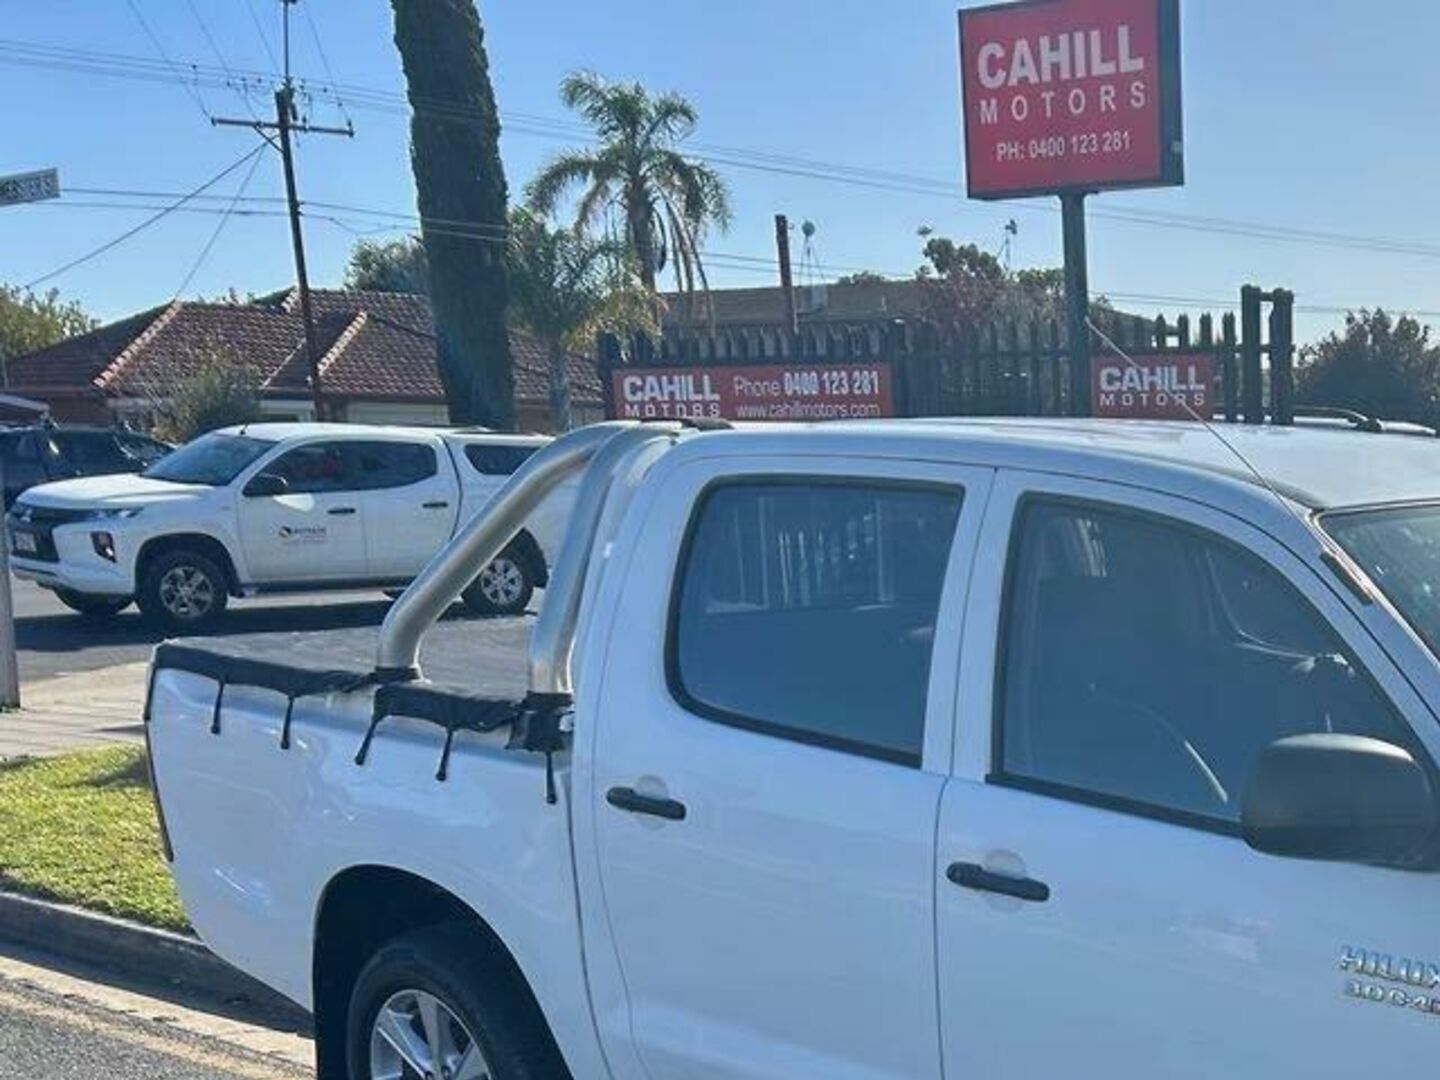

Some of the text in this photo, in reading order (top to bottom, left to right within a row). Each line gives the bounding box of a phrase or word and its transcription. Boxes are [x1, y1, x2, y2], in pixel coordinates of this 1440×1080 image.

[978, 25, 1144, 89] CAHILL
[979, 81, 1146, 125] MOTORS
[996, 130, 1130, 161] PH: 0400 123 281
[623, 371, 879, 401] CAHILL Phone 0400 123 281
[1100, 366, 1205, 392] CAHILL
[625, 402, 881, 418] MOTORS www.cahillmotors.com
[1100, 393, 1205, 407] MOTORS
